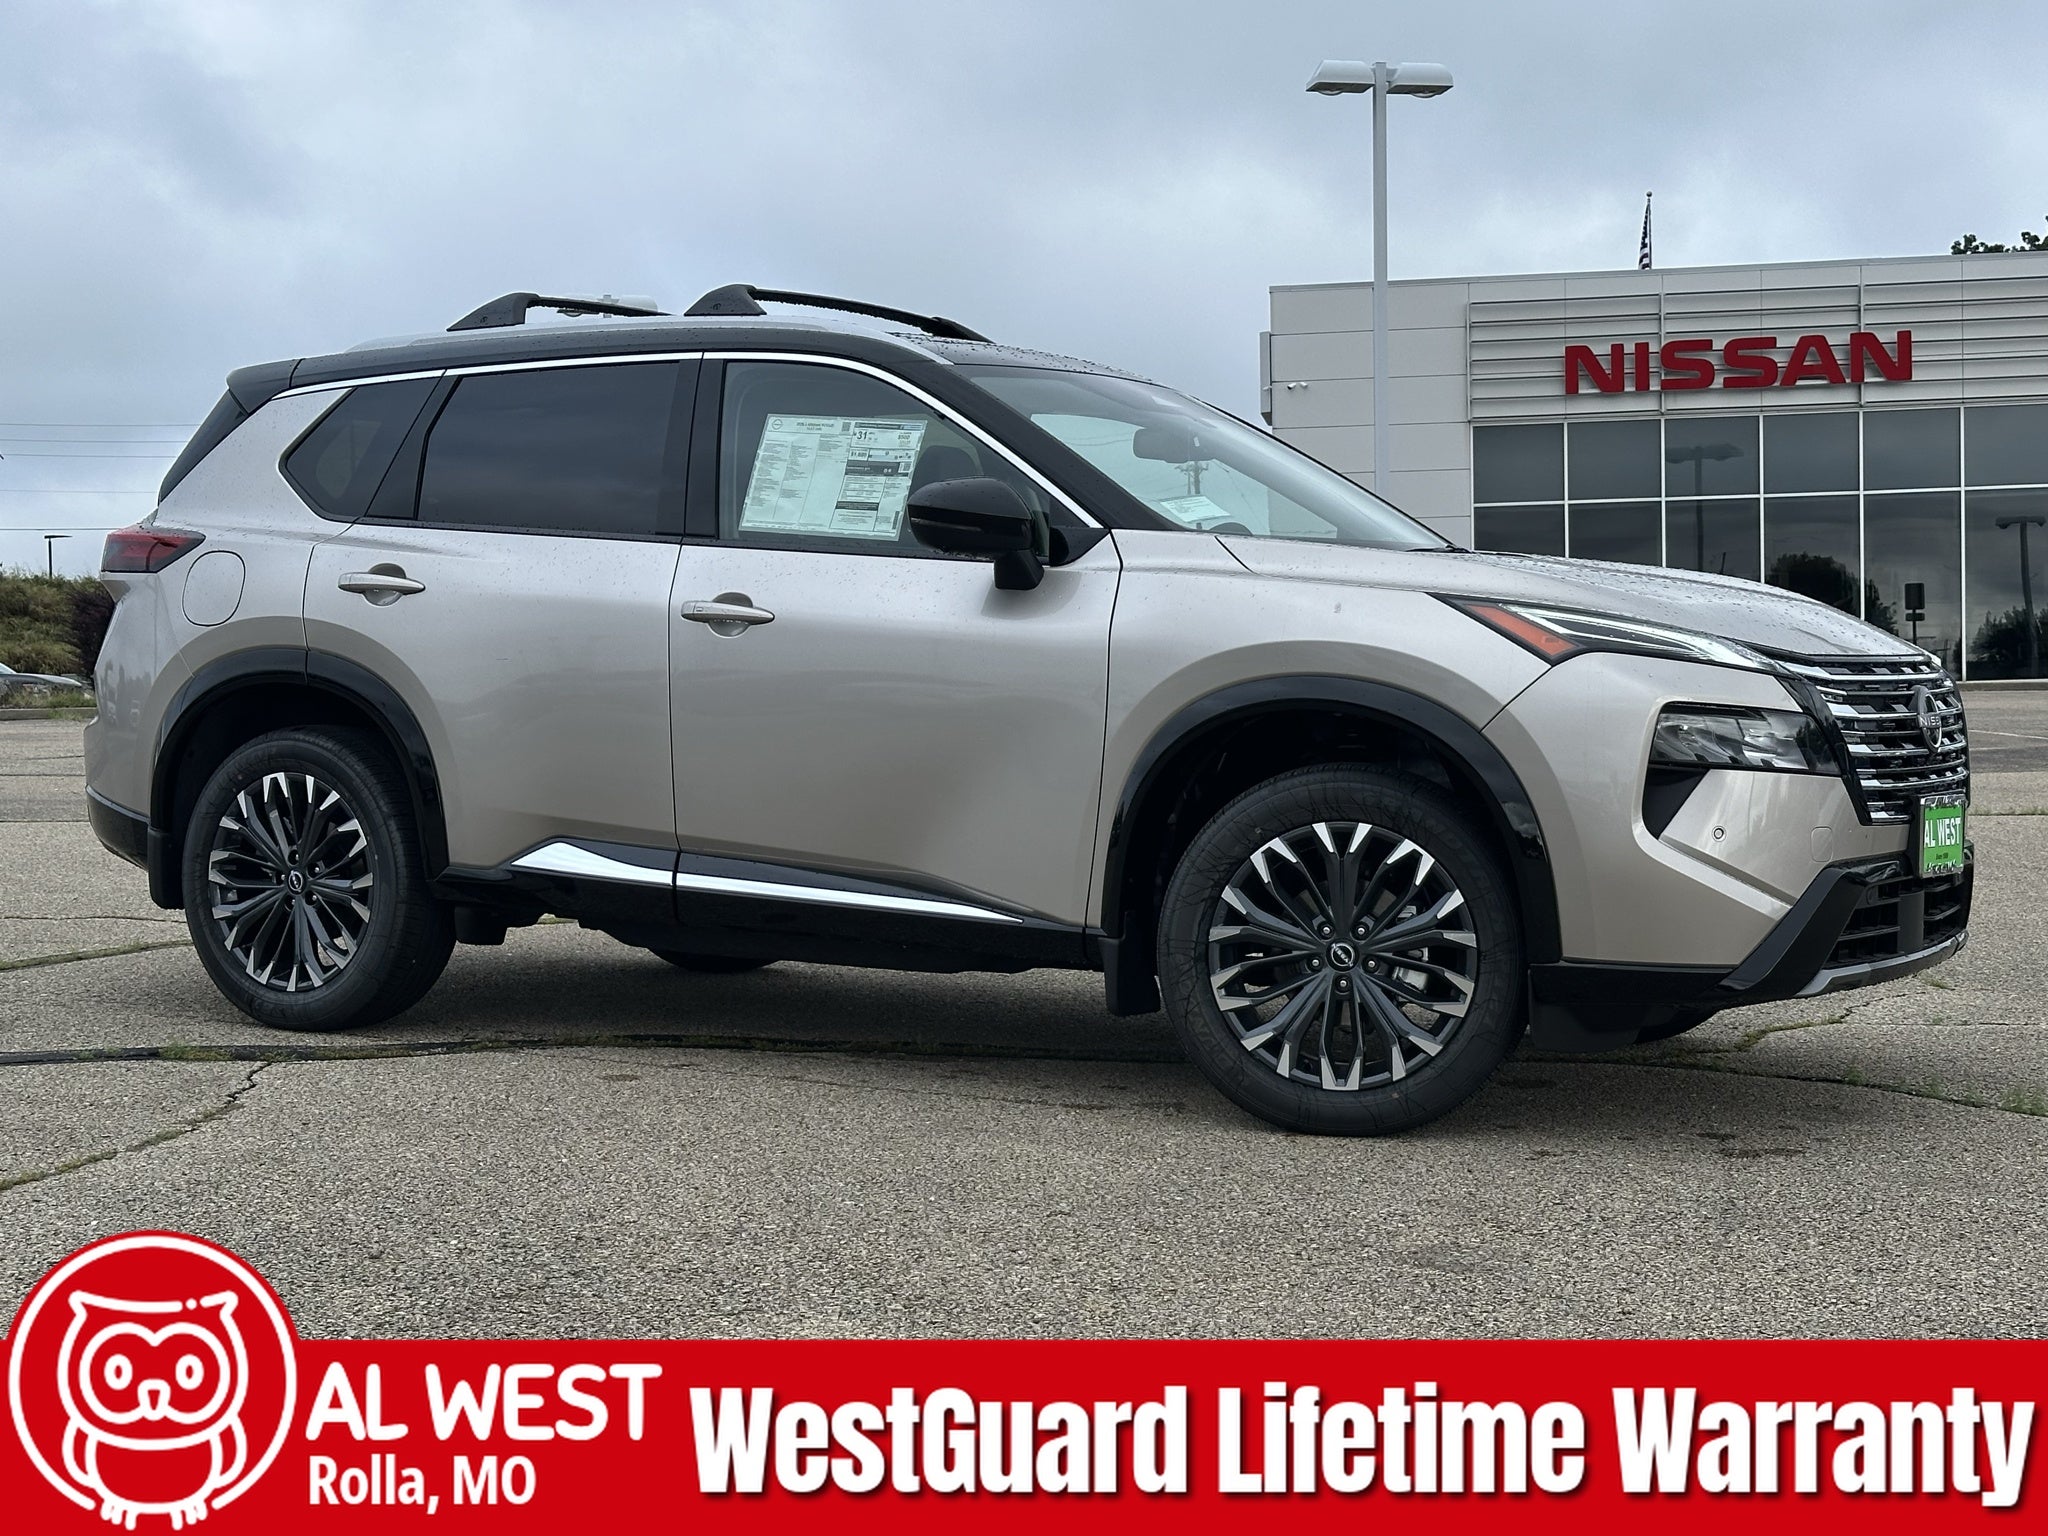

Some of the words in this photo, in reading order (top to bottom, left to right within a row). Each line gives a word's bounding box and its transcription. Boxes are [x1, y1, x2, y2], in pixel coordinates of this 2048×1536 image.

[1564, 330, 1913, 395] NISSAN
[1924, 820, 1936, 848] AL
[1937, 817, 1961, 847] WEST
